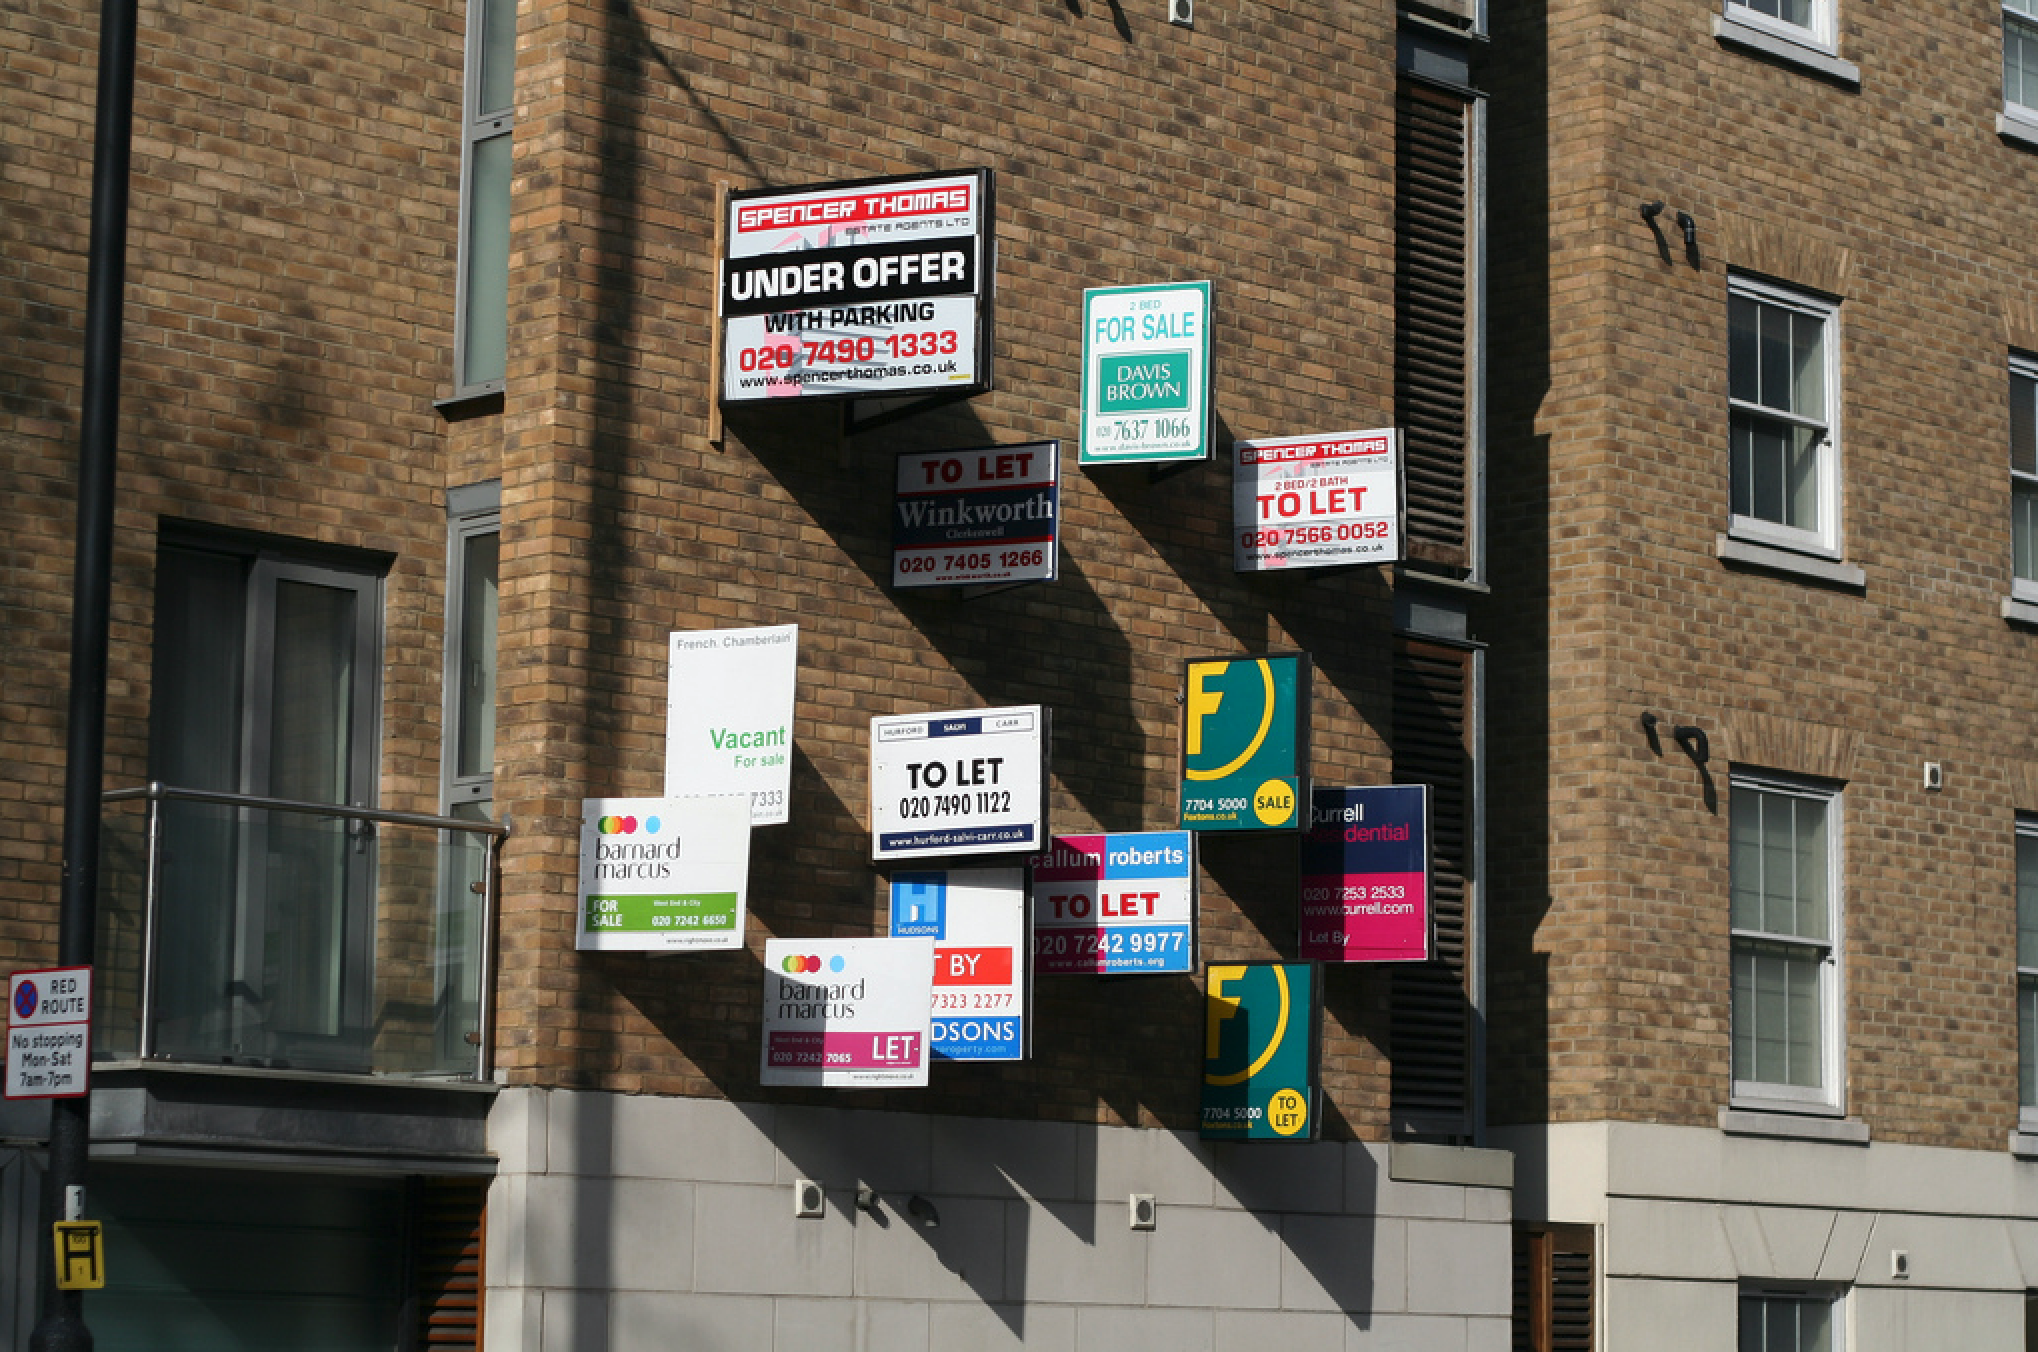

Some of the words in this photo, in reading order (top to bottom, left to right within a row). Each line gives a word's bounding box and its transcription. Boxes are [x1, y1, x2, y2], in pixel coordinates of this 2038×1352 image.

[741, 200, 856, 229] SPENCER
[864, 189, 967, 215] THOMAS
[946, 217, 969, 228] LTD
[731, 261, 845, 300] UNDER
[853, 251, 965, 288] OFFER
[1130, 301, 1136, 311] 2
[1139, 299, 1162, 311] BED
[766, 311, 822, 332] WITH
[830, 302, 935, 326] PARKING
[1095, 315, 1135, 344] FOR
[1141, 311, 1195, 340] SALE
[740, 344, 793, 372] 020
[802, 336, 874, 366] 7490
[885, 330, 958, 358] 1333
[740, 360, 957, 388] www.spencerthomas.co.uk
[1117, 362, 1171, 383] DAVIS
[1107, 381, 1181, 401] BROWN
[1095, 425, 1111, 438] 020
[1113, 419, 1149, 441] 7637
[1154, 418, 1191, 439] 1066
[1241, 446, 1317, 464] SPENCER
[1321, 439, 1385, 456] THOMAS
[922, 459, 963, 485] TO
[978, 452, 1034, 481] LET
[1275, 481, 1281, 490] 2
[1319, 475, 1349, 487] BATH
[898, 492, 1053, 528] Winkworth
[1256, 491, 1301, 519] TO
[1309, 486, 1368, 515] LET
[1241, 529, 1279, 548] 020
[1284, 525, 1332, 544] 7566
[1337, 521, 1389, 541] 0052
[900, 556, 936, 573] 020
[944, 553, 991, 571] 7405
[1000, 550, 1043, 568] 1266
[1187, 660, 1230, 755] F
[709, 726, 786, 750] Vacant
[884, 726, 924, 737] HURFORD
[996, 719, 1018, 729] CARR
[733, 755, 757, 768] For
[761, 753, 785, 767] sale
[906, 761, 947, 790] TO
[955, 757, 1004, 786] LET
[751, 790, 784, 807] 7333
[900, 796, 930, 819] 020
[934, 793, 971, 817] 7490
[976, 790, 1011, 814] 1122
[1185, 799, 1214, 811] 7704
[1217, 797, 1248, 811] 5000
[1257, 796, 1291, 809] SALE
[595, 836, 681, 861] barnard
[1030, 849, 1101, 868] callum
[1109, 846, 1184, 867] roberts
[594, 862, 671, 881] marcus
[1303, 888, 1329, 900] 020
[1335, 886, 1367, 900] 7253
[1371, 885, 1405, 899] 2533
[593, 900, 618, 912] FOR
[1049, 893, 1091, 918] TO
[1101, 891, 1160, 917] LET
[592, 914, 623, 927] SALE
[651, 915, 671, 927] 020
[897, 924, 939, 935] HUDSONS
[1073, 933, 1124, 954] 7242
[1130, 931, 1184, 953] 9977
[1333, 930, 1350, 946] By
[949, 953, 982, 977] BY
[50, 978, 77, 994] RED
[779, 978, 865, 1001] barnard
[42, 997, 84, 1014] ROUTE
[778, 1002, 855, 1019] marcus
[931, 993, 967, 1009] 7323
[974, 992, 1013, 1009] 2277
[1206, 966, 1248, 1059] F
[12, 1034, 29, 1049] No
[32, 1031, 82, 1050] stopping
[932, 1021, 1015, 1042] DSONS
[773, 1051, 793, 1063] 020
[797, 1051, 822, 1063] 7242
[826, 1051, 852, 1063] 7065
[872, 1036, 915, 1061] LET
[21, 1051, 72, 1068] Mon-Sat
[20, 1071, 72, 1089] 7am-7pm
[1204, 1108, 1231, 1119] 7704
[1234, 1107, 1262, 1119] 5000
[1277, 1095, 1297, 1110] TO
[1276, 1113, 1298, 1127] LET
[63, 1227, 97, 1282] H
